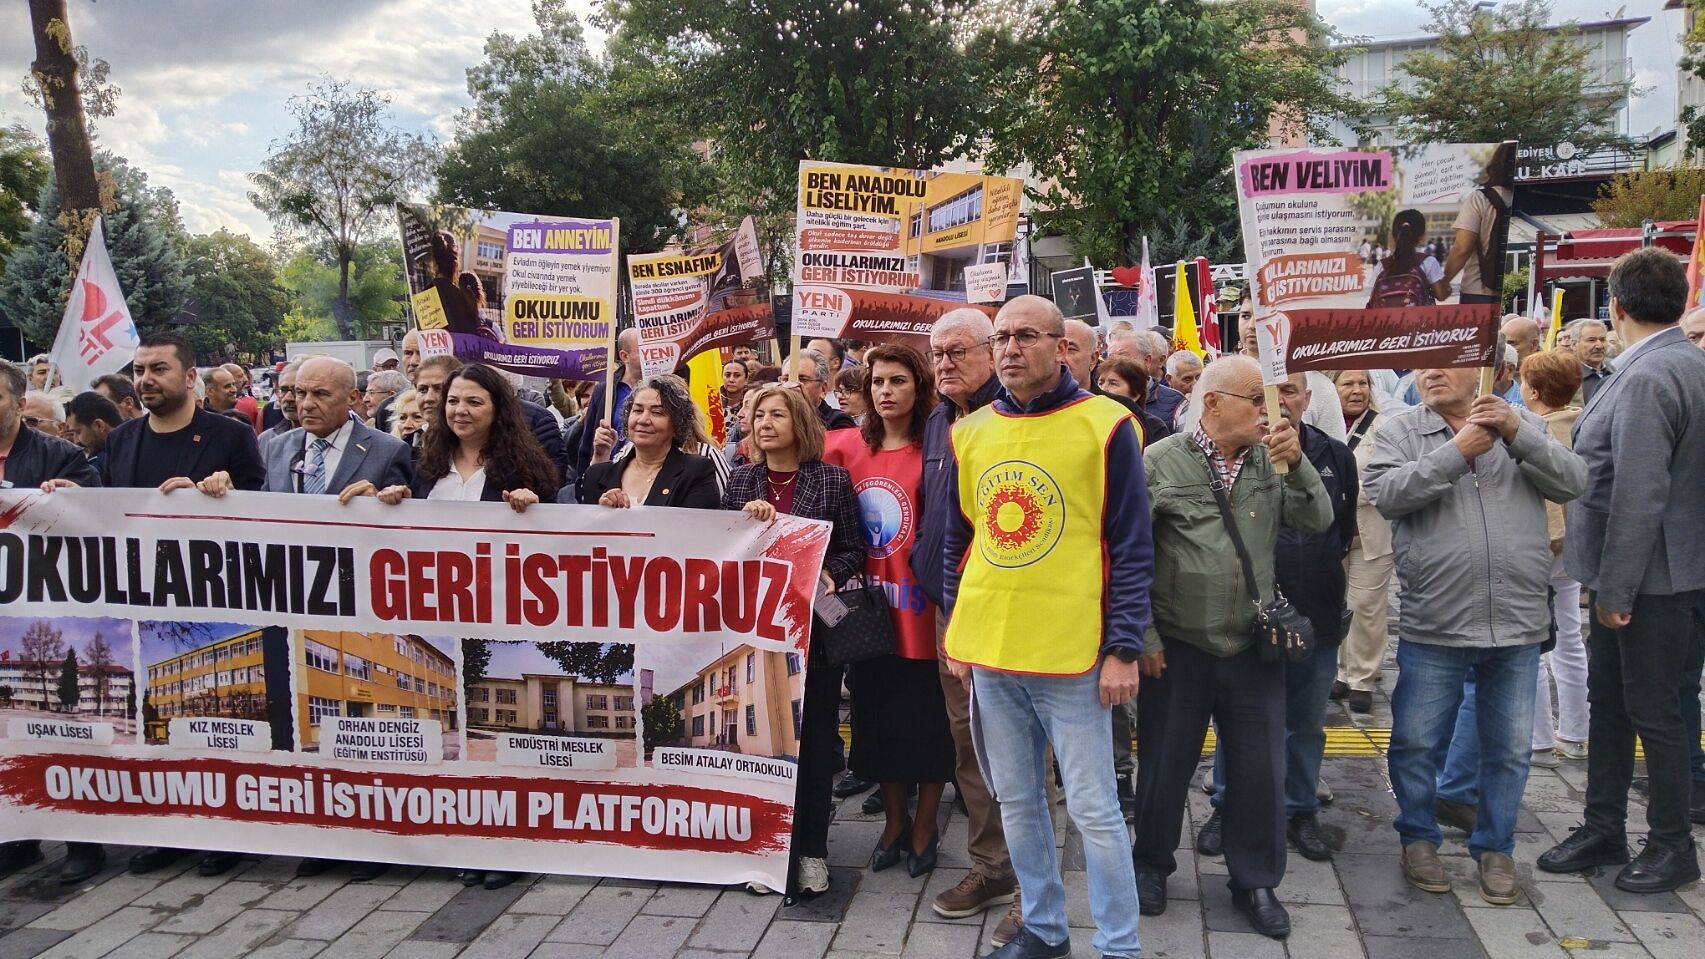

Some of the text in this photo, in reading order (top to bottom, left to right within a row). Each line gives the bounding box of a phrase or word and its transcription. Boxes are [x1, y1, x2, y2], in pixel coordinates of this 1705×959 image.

[1516, 145, 1553, 158] EDİYESİ
[1250, 159, 1388, 192] BEN VELİYİM.
[808, 173, 926, 197] BEN ANADOLU
[807, 190, 899, 214] LİSELİYİM.
[1288, 200, 1318, 209] okuluna
[825, 212, 842, 221] güçlü
[853, 215, 877, 224] gelecek
[878, 217, 889, 225] için
[1271, 211, 1313, 220] ulaşmasını
[1315, 210, 1355, 219] istiyorum.
[832, 221, 852, 229] eğitim
[1299, 226, 1322, 234] servis
[513, 226, 612, 249] BEN ANNEYİM.
[1299, 236, 1319, 246] bağlı
[1321, 236, 1351, 244] olmasını
[513, 257, 537, 267] Evladım
[538, 259, 560, 270] öğleyin
[561, 261, 581, 271] yemek
[632, 255, 720, 278] BEN ESNAFIM.
[802, 253, 905, 272] OKULLARIMIZI
[512, 269, 577, 283] Okul civarında yemek
[802, 265, 837, 282] GERİ
[511, 280, 547, 292] yiyebileceği
[558, 285, 568, 294] yer
[569, 285, 582, 294] yok.
[799, 291, 843, 311] YENİ
[514, 300, 600, 320] OKULUMU
[802, 310, 839, 318] PARTİ
[513, 319, 609, 338] GERİ İSTİYORUM
[641, 326, 665, 340] GERİ
[852, 319, 912, 331] OKULLARIMIZI
[421, 332, 449, 349] YENİ
[1292, 326, 1479, 360] OKULLARIMIZI GERİ İSTİYORUZ
[513, 353, 528, 364] GERİ
[641, 346, 674, 360] YENİ
[1028, 476, 1057, 507] SEN
[0, 532, 356, 616] OKULLARIMIZI
[369, 543, 492, 624] GERİ
[505, 544, 791, 642] İSTİYORUZ
[27, 723, 93, 740] UŞAK LİSESİ
[190, 721, 254, 736] KIZ MESLEK
[338, 720, 420, 734] ORHAN DENGİZ
[207, 735, 238, 749] LİSESİ
[335, 734, 424, 748] ANADOLU LİSESİ
[509, 736, 604, 754] ENDÜSTRİ MESLEK
[333, 747, 428, 763] (EĞİTİM ENSTİTÜSÜ)
[539, 752, 573, 768] LİSESİ
[661, 749, 793, 780] BESİM ATALAY ORTAOKULU
[45, 765, 752, 842] OKULUMU GERİ İSTİYORUM PLATFORMU
